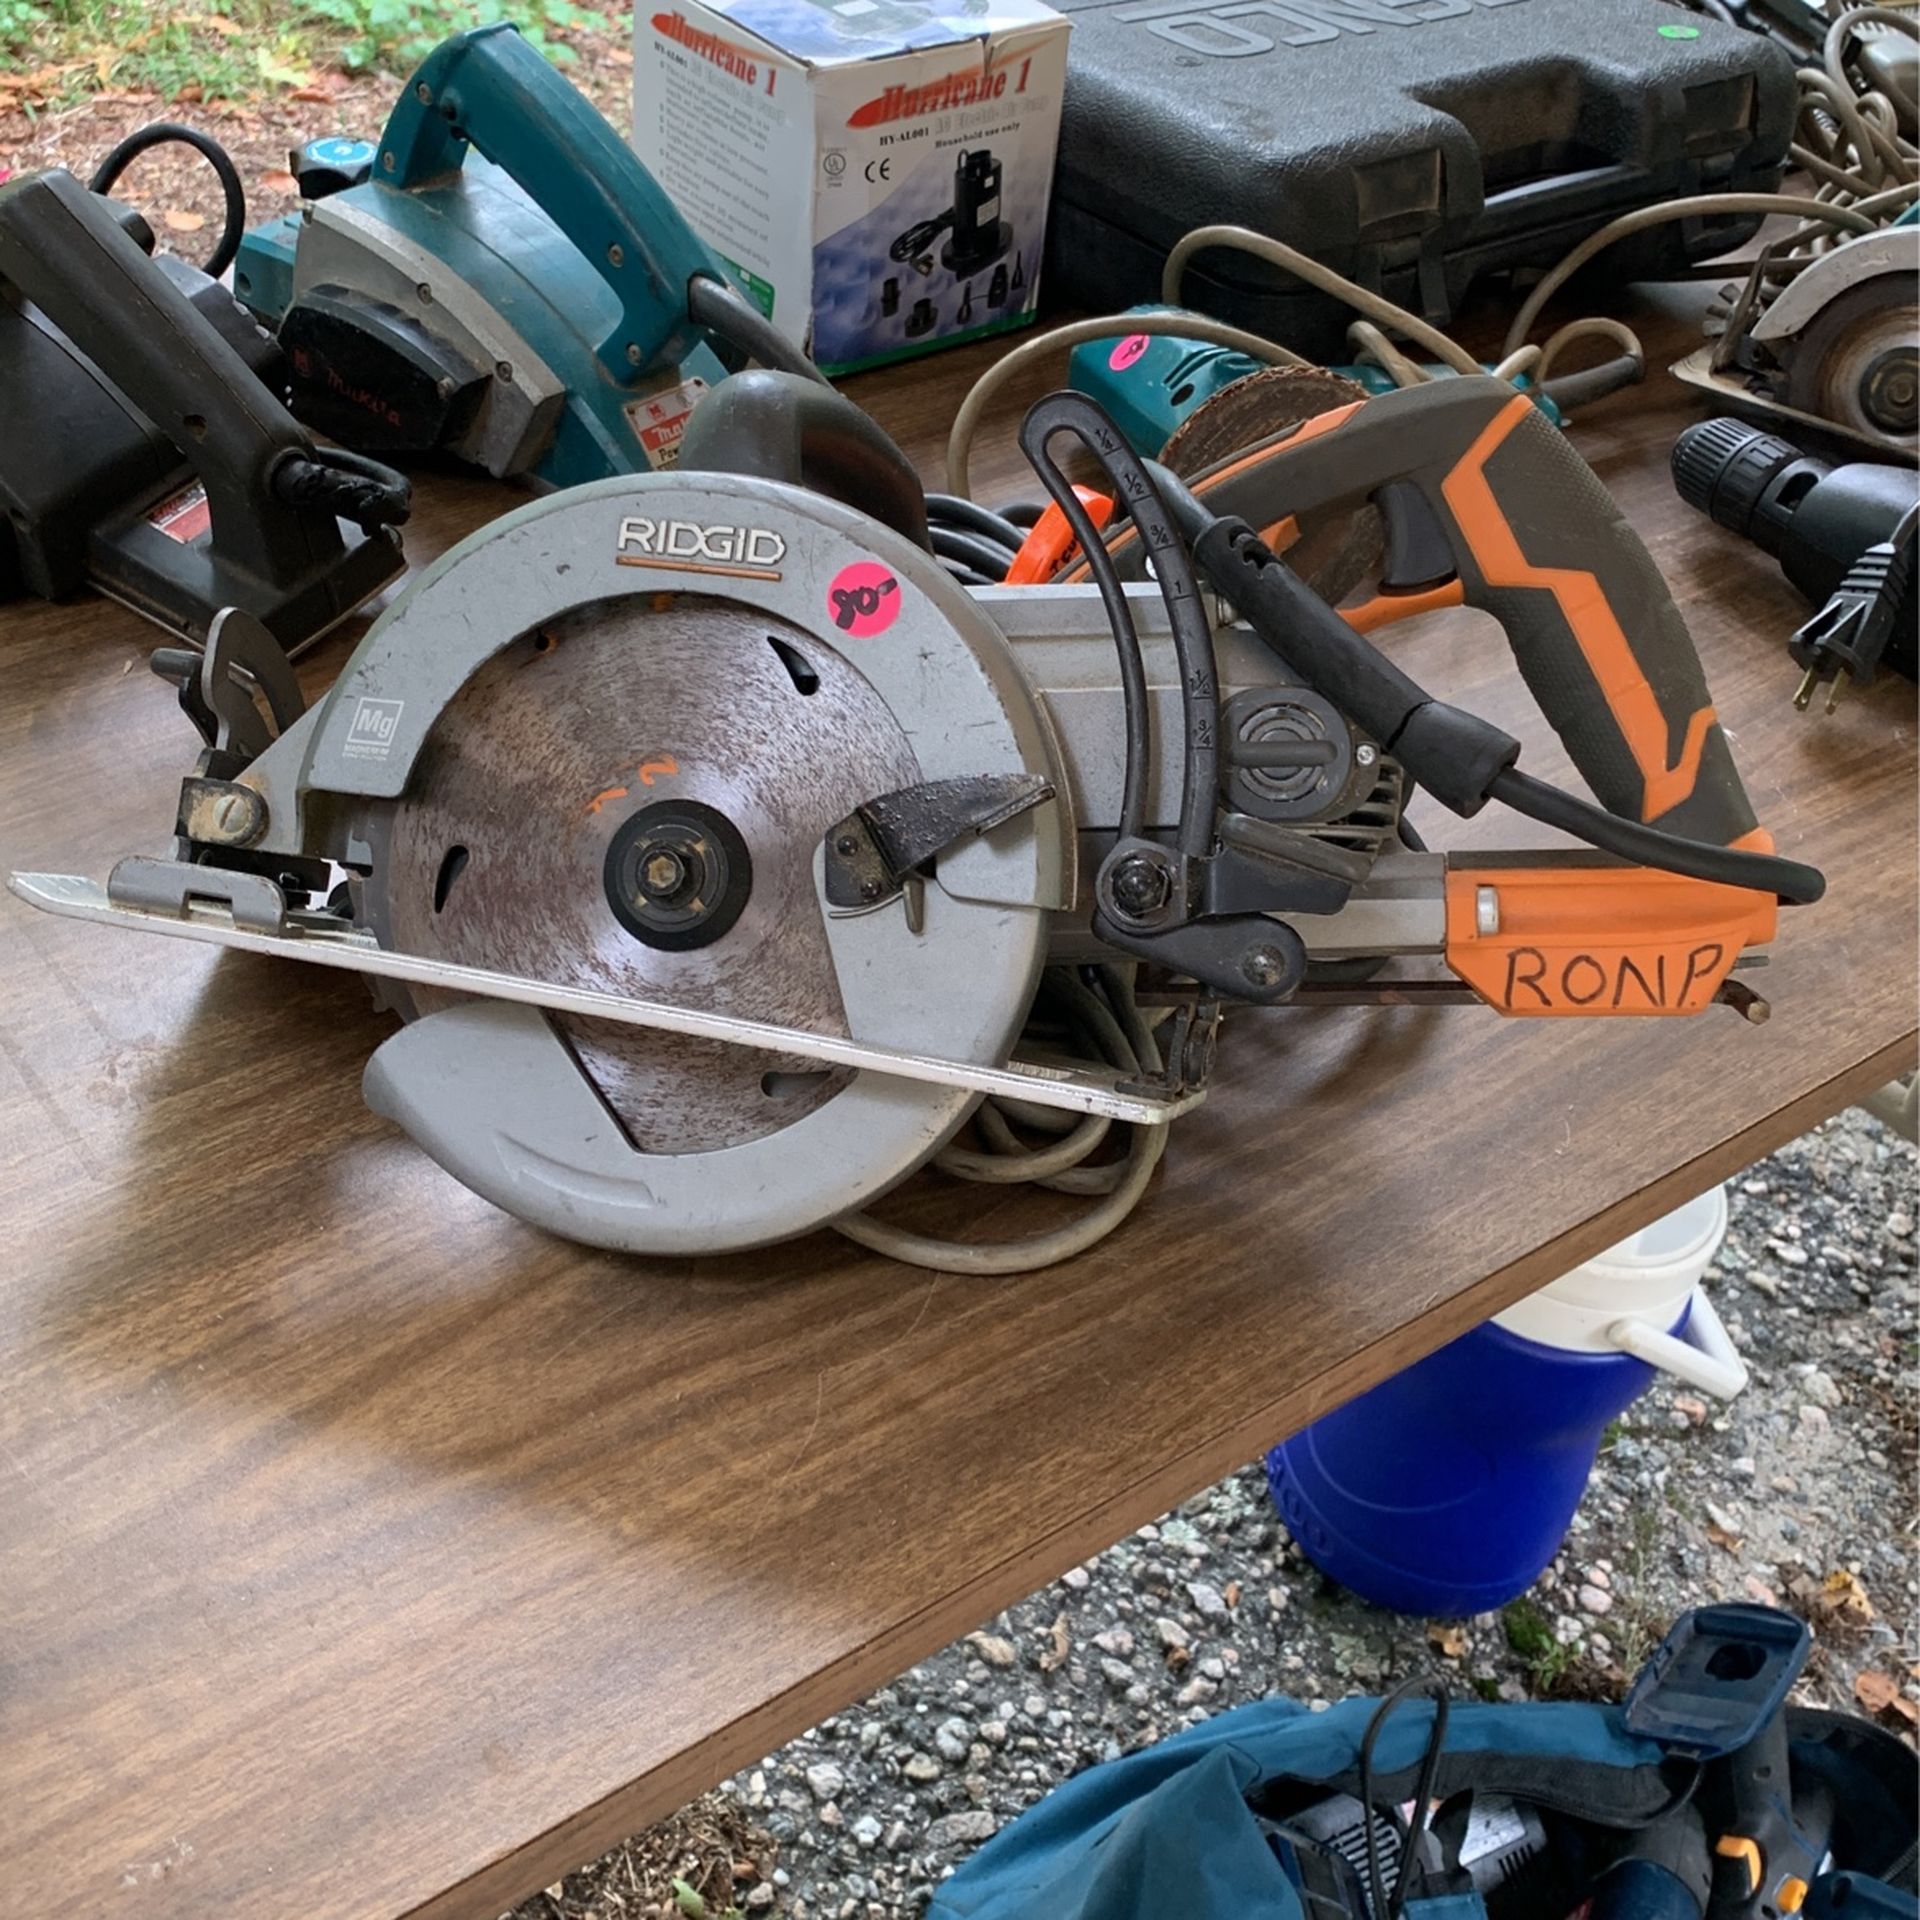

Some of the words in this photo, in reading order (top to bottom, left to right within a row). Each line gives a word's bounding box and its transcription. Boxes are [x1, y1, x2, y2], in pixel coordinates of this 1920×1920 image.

[667, 9, 757, 86] Hurricane
[765, 68, 776, 97] 1
[881, 69, 1007, 122] Hurricane
[1015, 57, 1032, 93] 1
[617, 516, 787, 566] RIDGID
[356, 708, 394, 739] Mg
